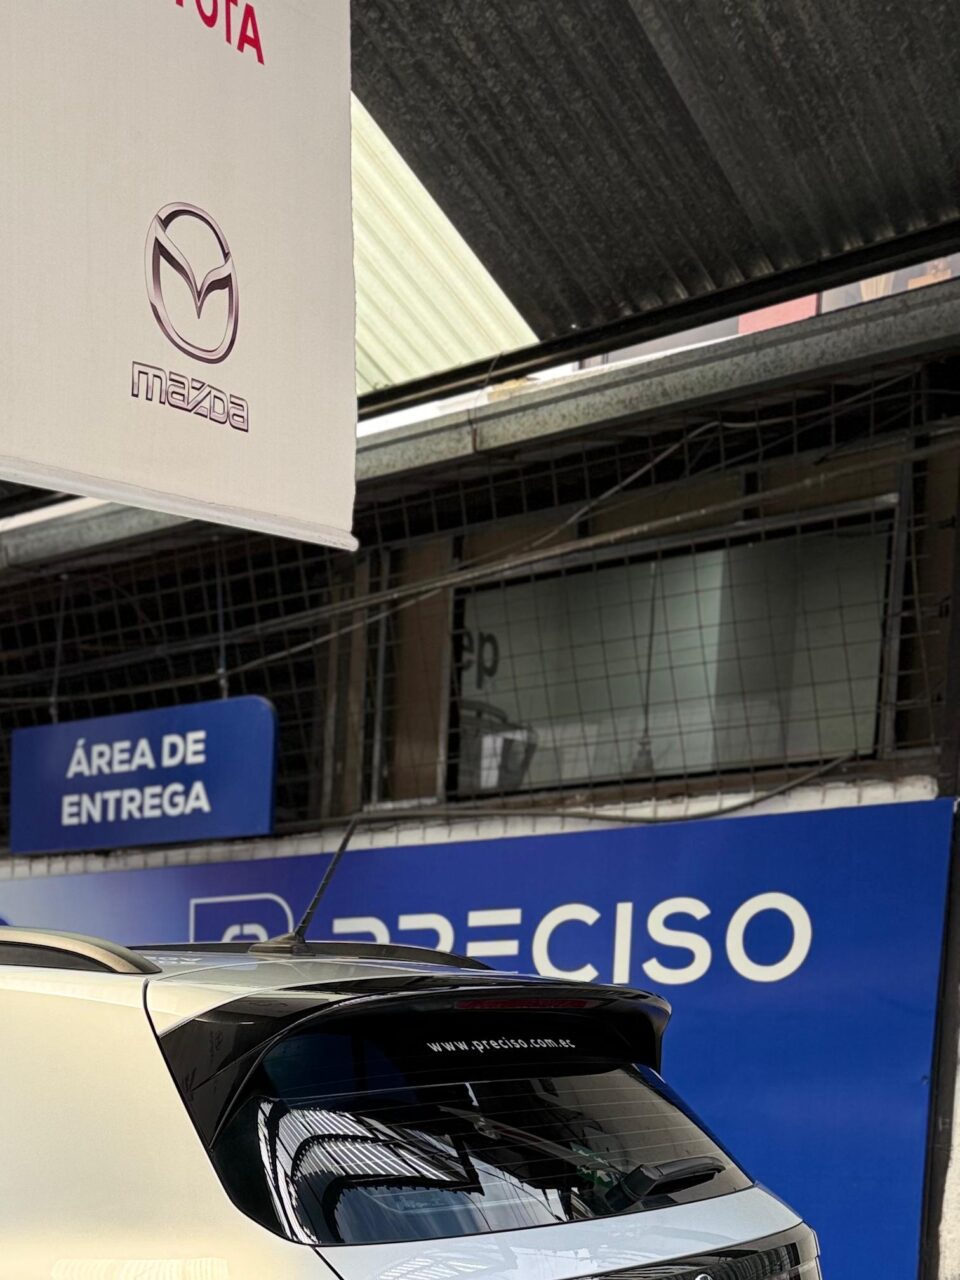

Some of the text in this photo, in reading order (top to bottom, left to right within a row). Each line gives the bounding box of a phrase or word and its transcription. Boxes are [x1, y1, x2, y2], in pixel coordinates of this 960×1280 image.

[66, 730, 208, 779] ÁREA DE
[61, 780, 212, 827] ENTREGA
[332, 891, 812, 986] ECISO
[426, 1036, 577, 1054] www.preciso.com.ec
